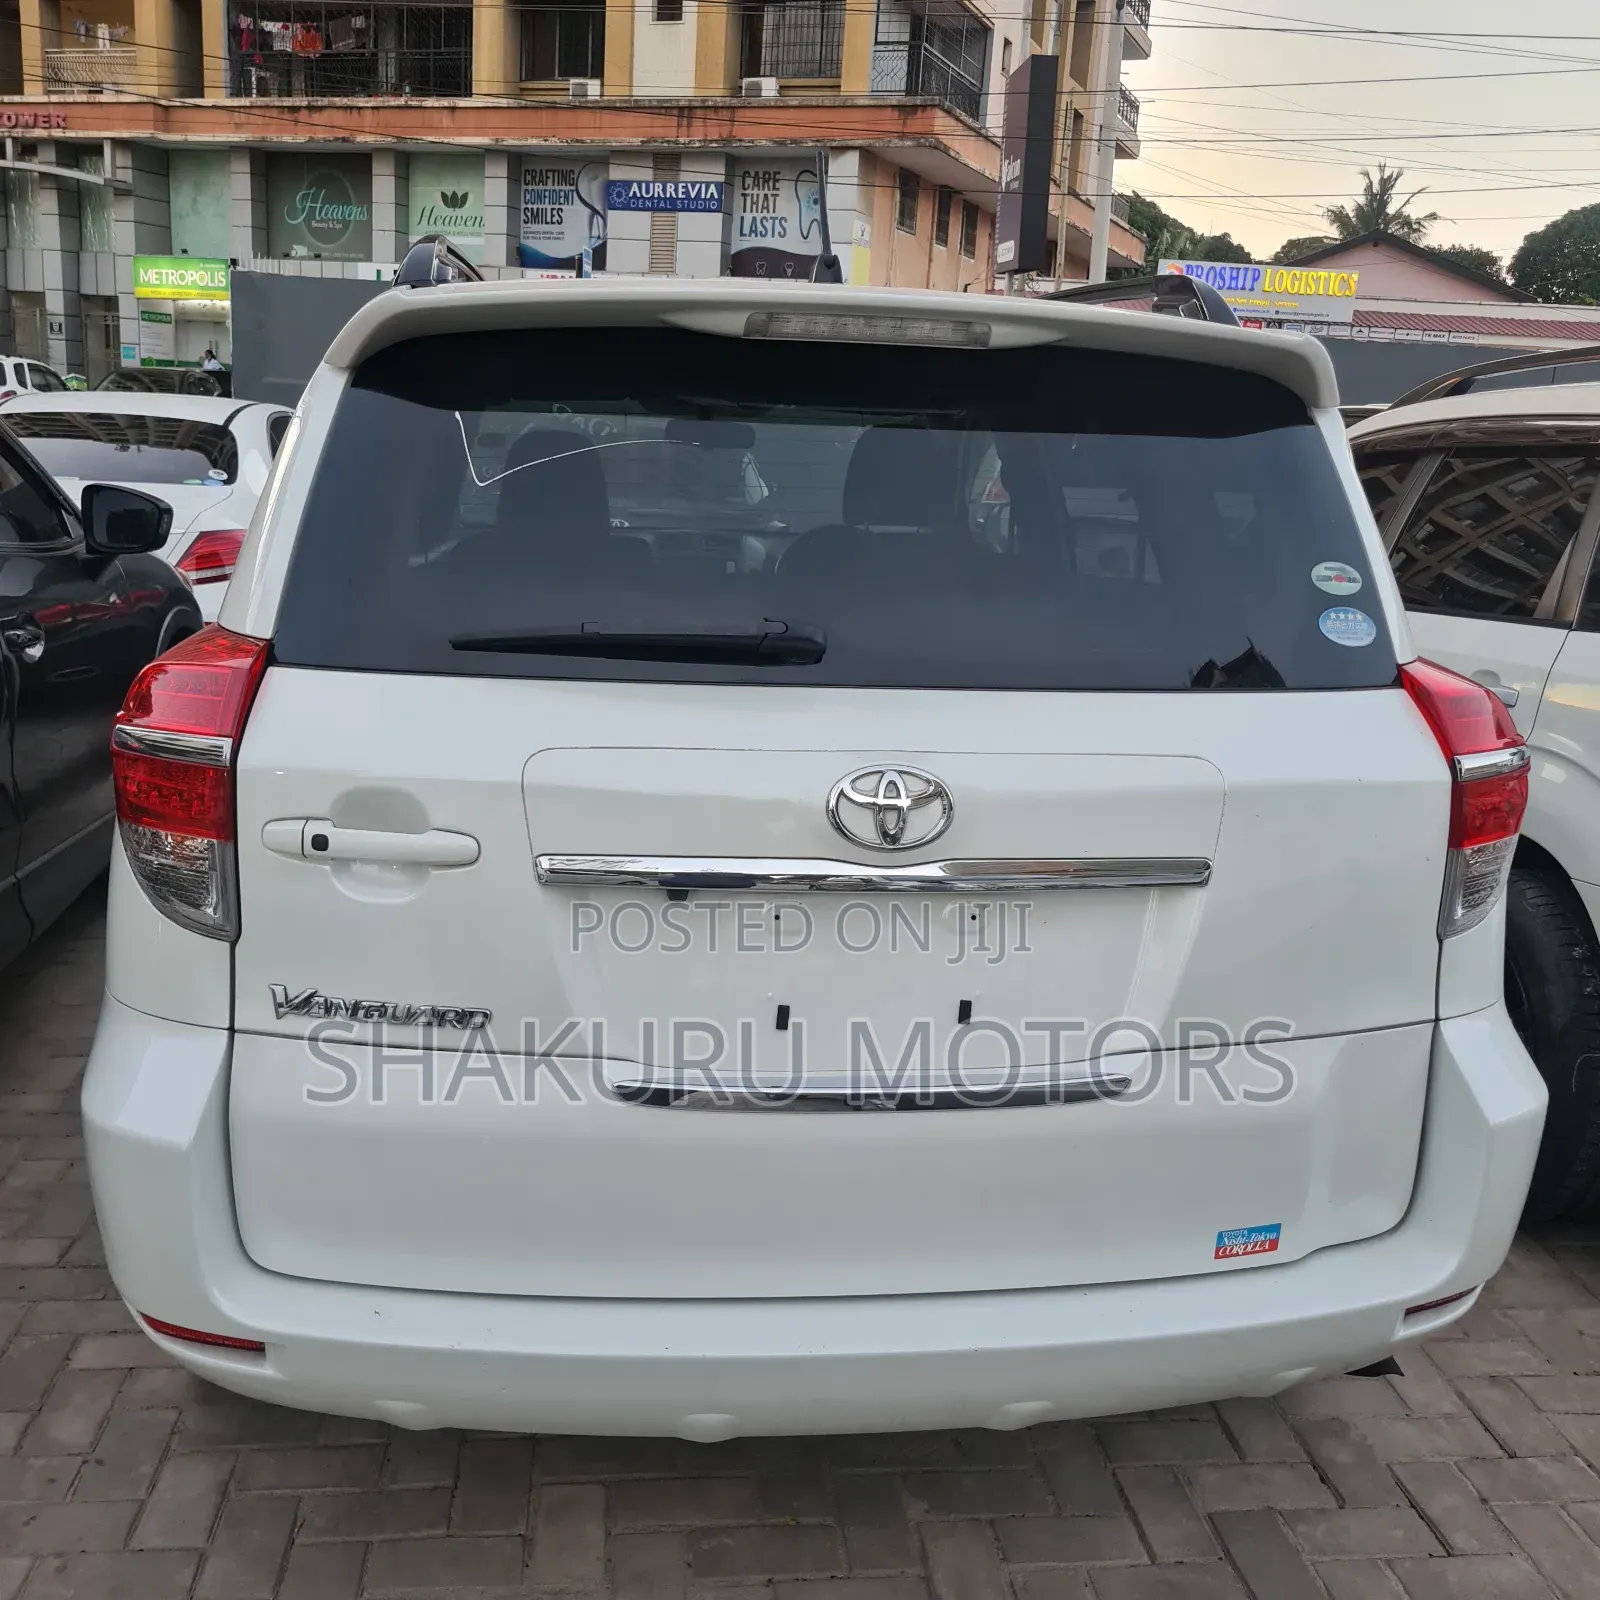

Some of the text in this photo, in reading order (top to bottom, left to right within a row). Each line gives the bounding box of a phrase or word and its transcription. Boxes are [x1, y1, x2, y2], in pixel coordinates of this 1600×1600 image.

[0, 111, 67, 129] OWER
[523, 168, 576, 187] CRAFTING
[741, 170, 781, 192] CARE
[523, 188, 576, 206] CONFIDENT
[628, 182, 719, 199] AURREVIA
[284, 186, 369, 224] Heavens
[630, 199, 718, 209] DENTAL STUDIO
[740, 193, 780, 214] THAT
[416, 205, 485, 228] Heaven
[523, 206, 564, 225] SMILES
[739, 215, 788, 239] LASTS
[139, 267, 227, 288] METROPOLIS
[1262, 267, 1359, 298] LOGISTICS
[268, 983, 493, 1030] VANGUARD
[1220, 1231, 1277, 1247] Nishi-Tokyo
[1221, 1229, 1249, 1239] TOYOTA
[1218, 1240, 1271, 1256] COROLLA
